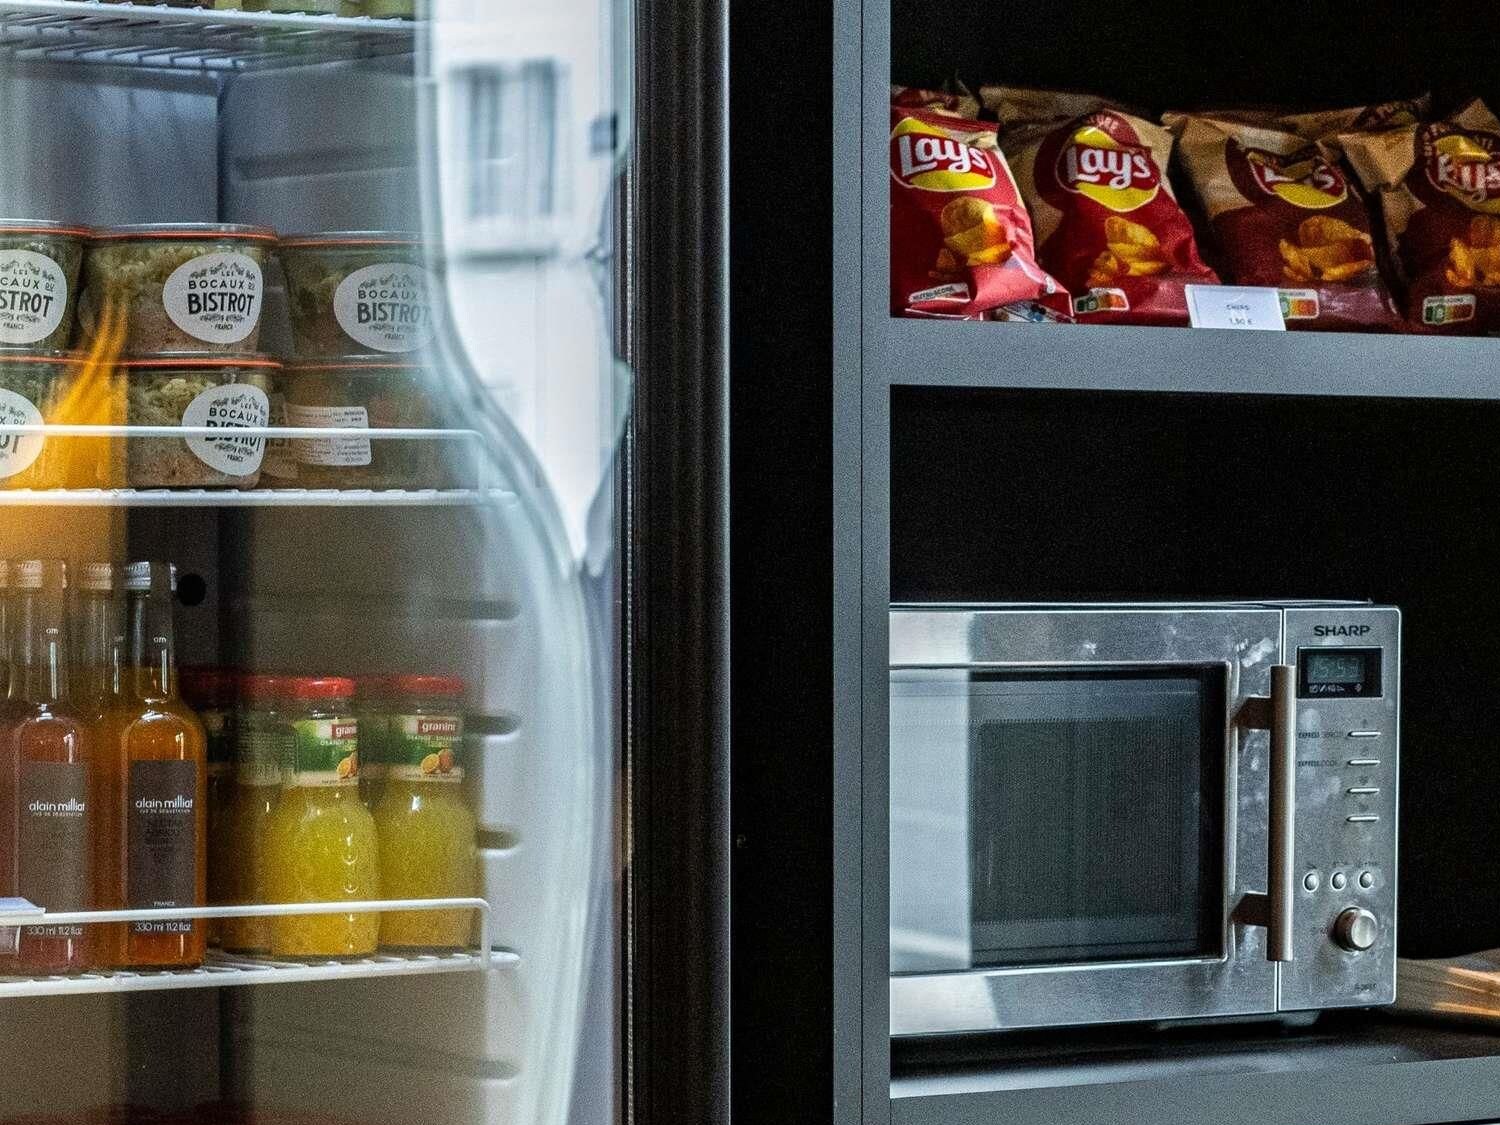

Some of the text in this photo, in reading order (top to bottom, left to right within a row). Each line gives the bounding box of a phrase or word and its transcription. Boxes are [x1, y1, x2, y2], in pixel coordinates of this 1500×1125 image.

[188, 280, 245, 290] BOCAUX
[187, 292, 255, 317] BISTROT
[209, 407, 258, 424] BOCAUX
[1313, 624, 1371, 637] SHARP
[29, 800, 57, 812] alain
[135, 796, 163, 808] alain
